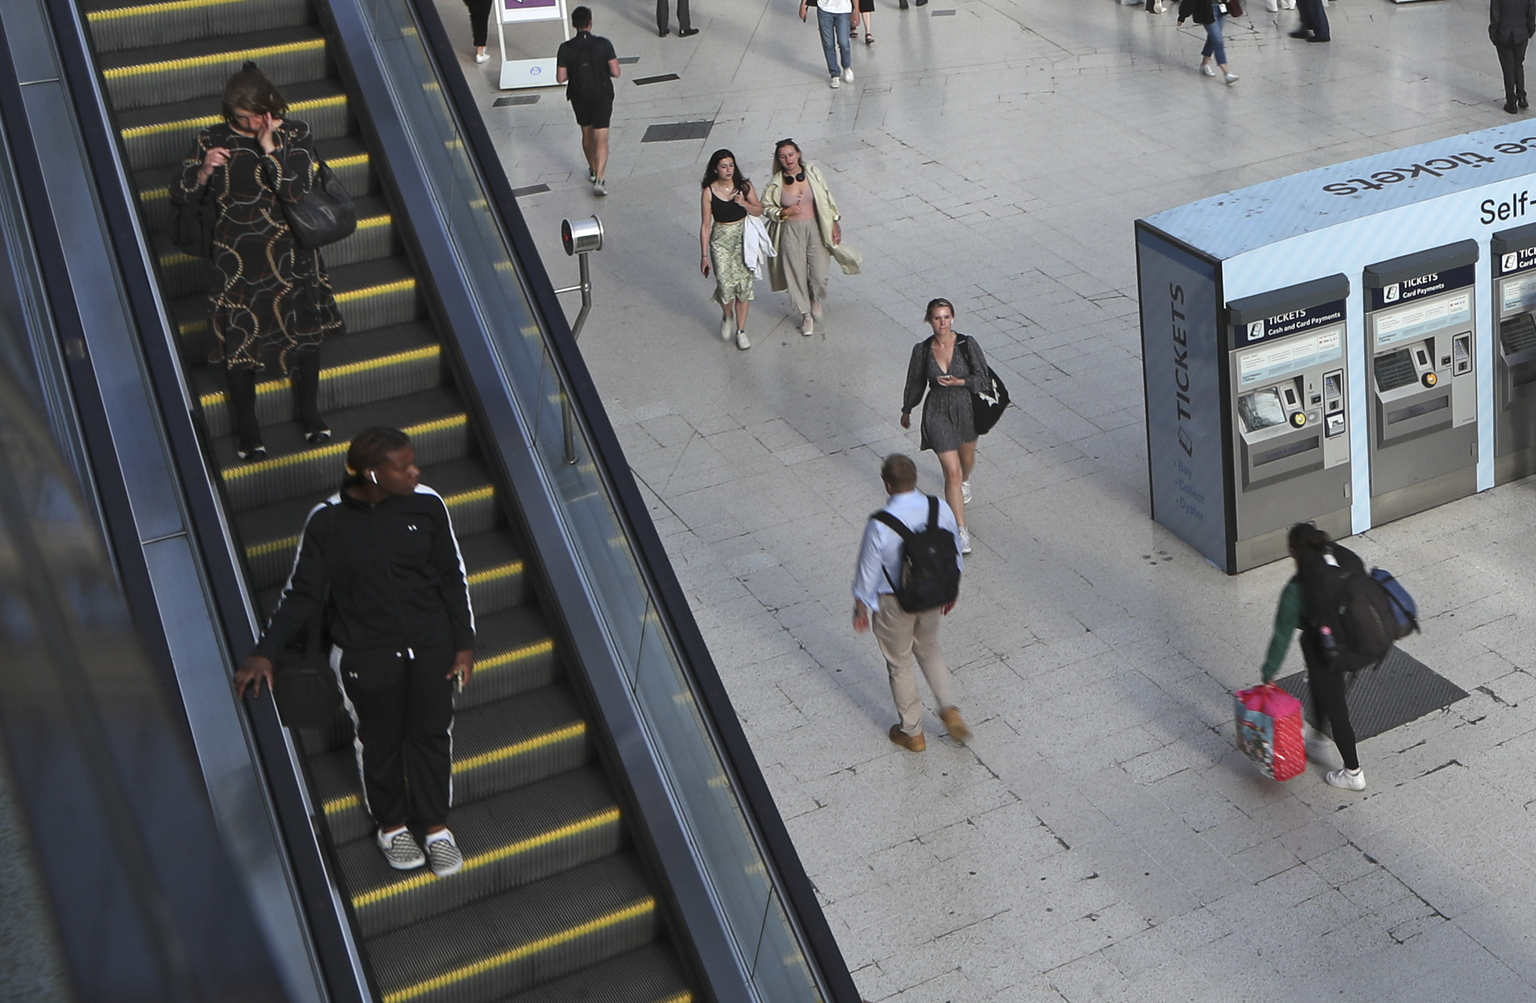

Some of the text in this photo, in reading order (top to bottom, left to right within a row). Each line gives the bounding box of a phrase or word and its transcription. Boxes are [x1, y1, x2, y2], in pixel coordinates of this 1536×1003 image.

[1322, 153, 1496, 197] tickets
[1519, 258, 1533, 268] Card
[1402, 283, 1445, 299] Card Payments
[1403, 272, 1438, 289] TICKETS
[1268, 309, 1307, 326] TICKETS
[1268, 311, 1341, 336] Cash and Card Payments
[1169, 282, 1192, 421] TICKETS
[1177, 460, 1193, 481] Buy
[1178, 479, 1205, 505] Collect
[1179, 497, 1205, 522] Oyster
